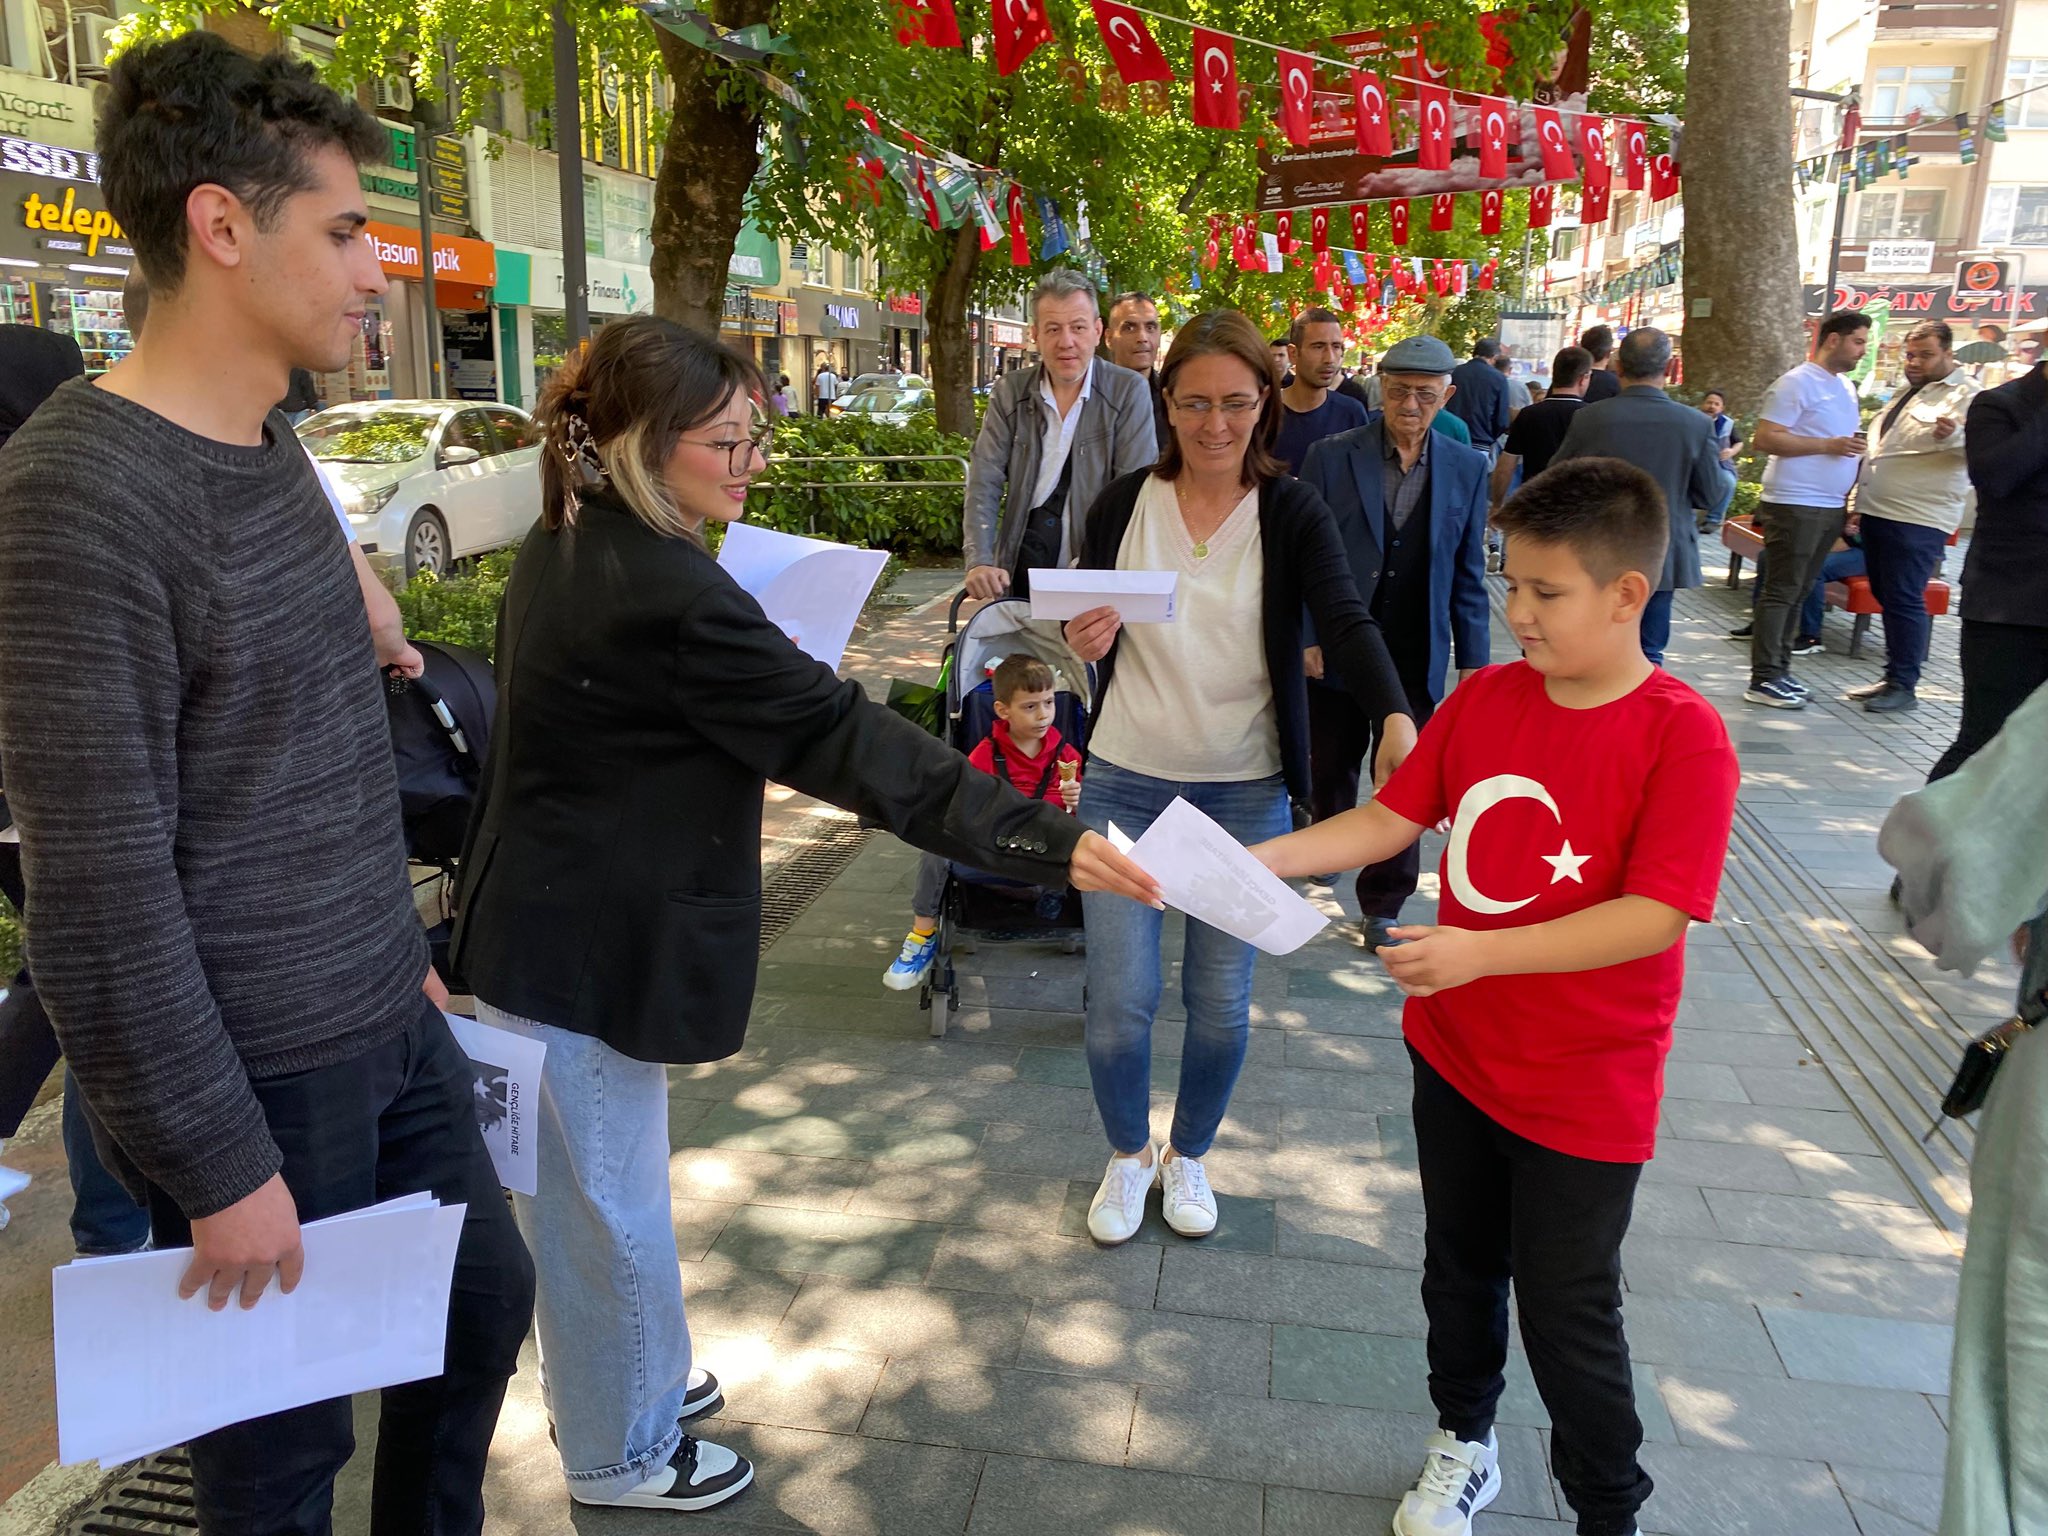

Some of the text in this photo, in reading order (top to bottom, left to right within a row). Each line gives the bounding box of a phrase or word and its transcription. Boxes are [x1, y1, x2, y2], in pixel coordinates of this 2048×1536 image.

[24, 187, 127, 257] telep
[432, 247, 461, 274] ptik
[509, 1082, 520, 1156] GENÇLİĞE HİTABE
